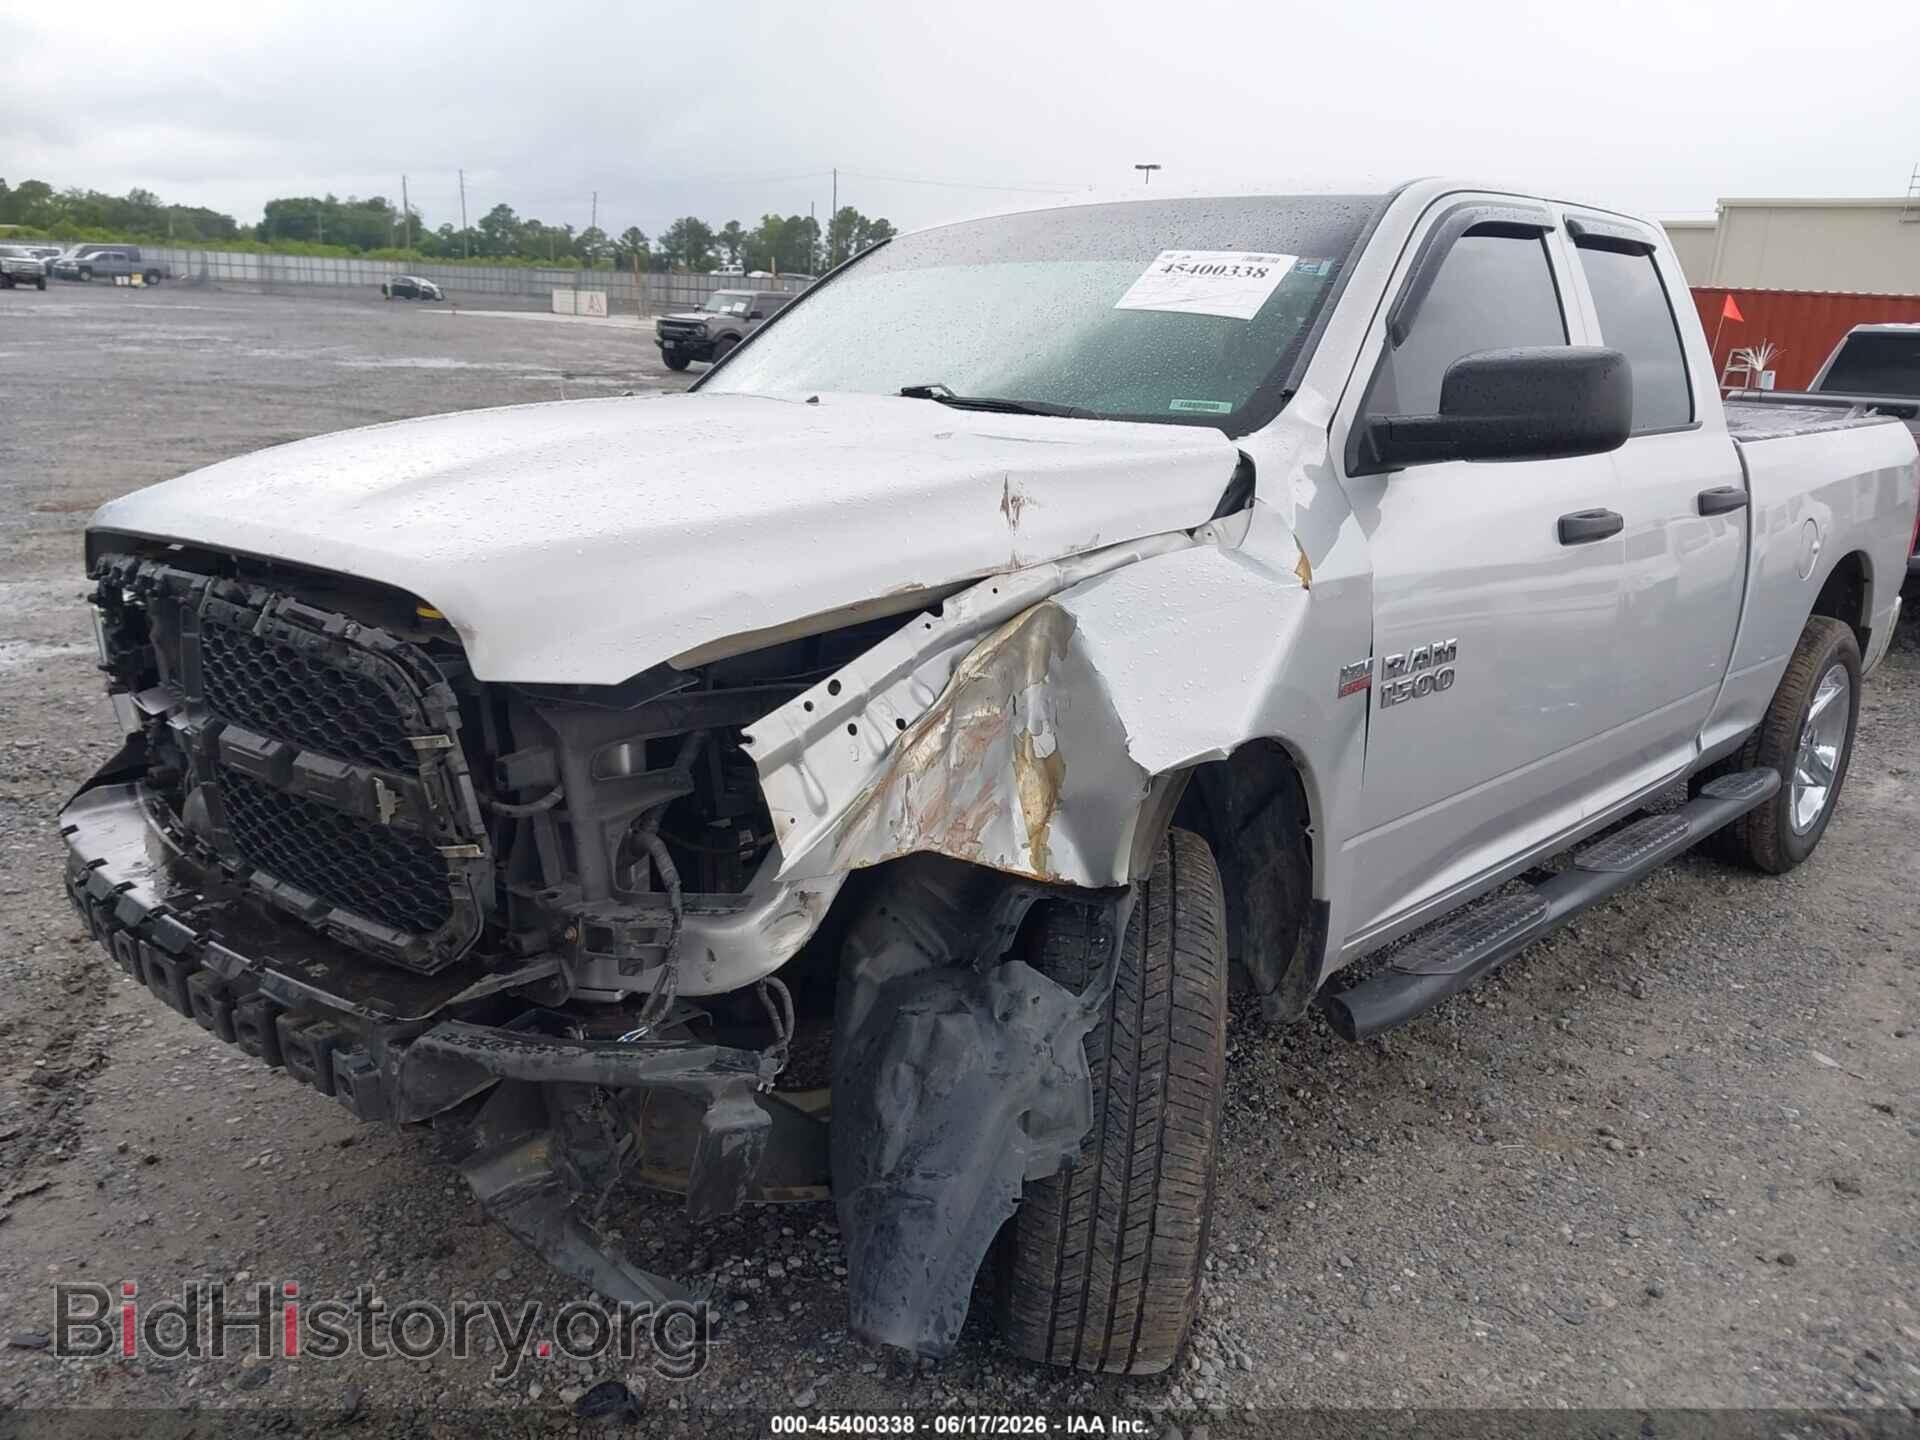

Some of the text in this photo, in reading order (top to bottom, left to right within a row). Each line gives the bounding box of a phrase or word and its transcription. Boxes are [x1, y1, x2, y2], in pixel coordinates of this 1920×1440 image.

[1160, 262, 1269, 280] 45400338
[1381, 638, 1457, 681] RAM
[1380, 665, 1455, 709] 1500
